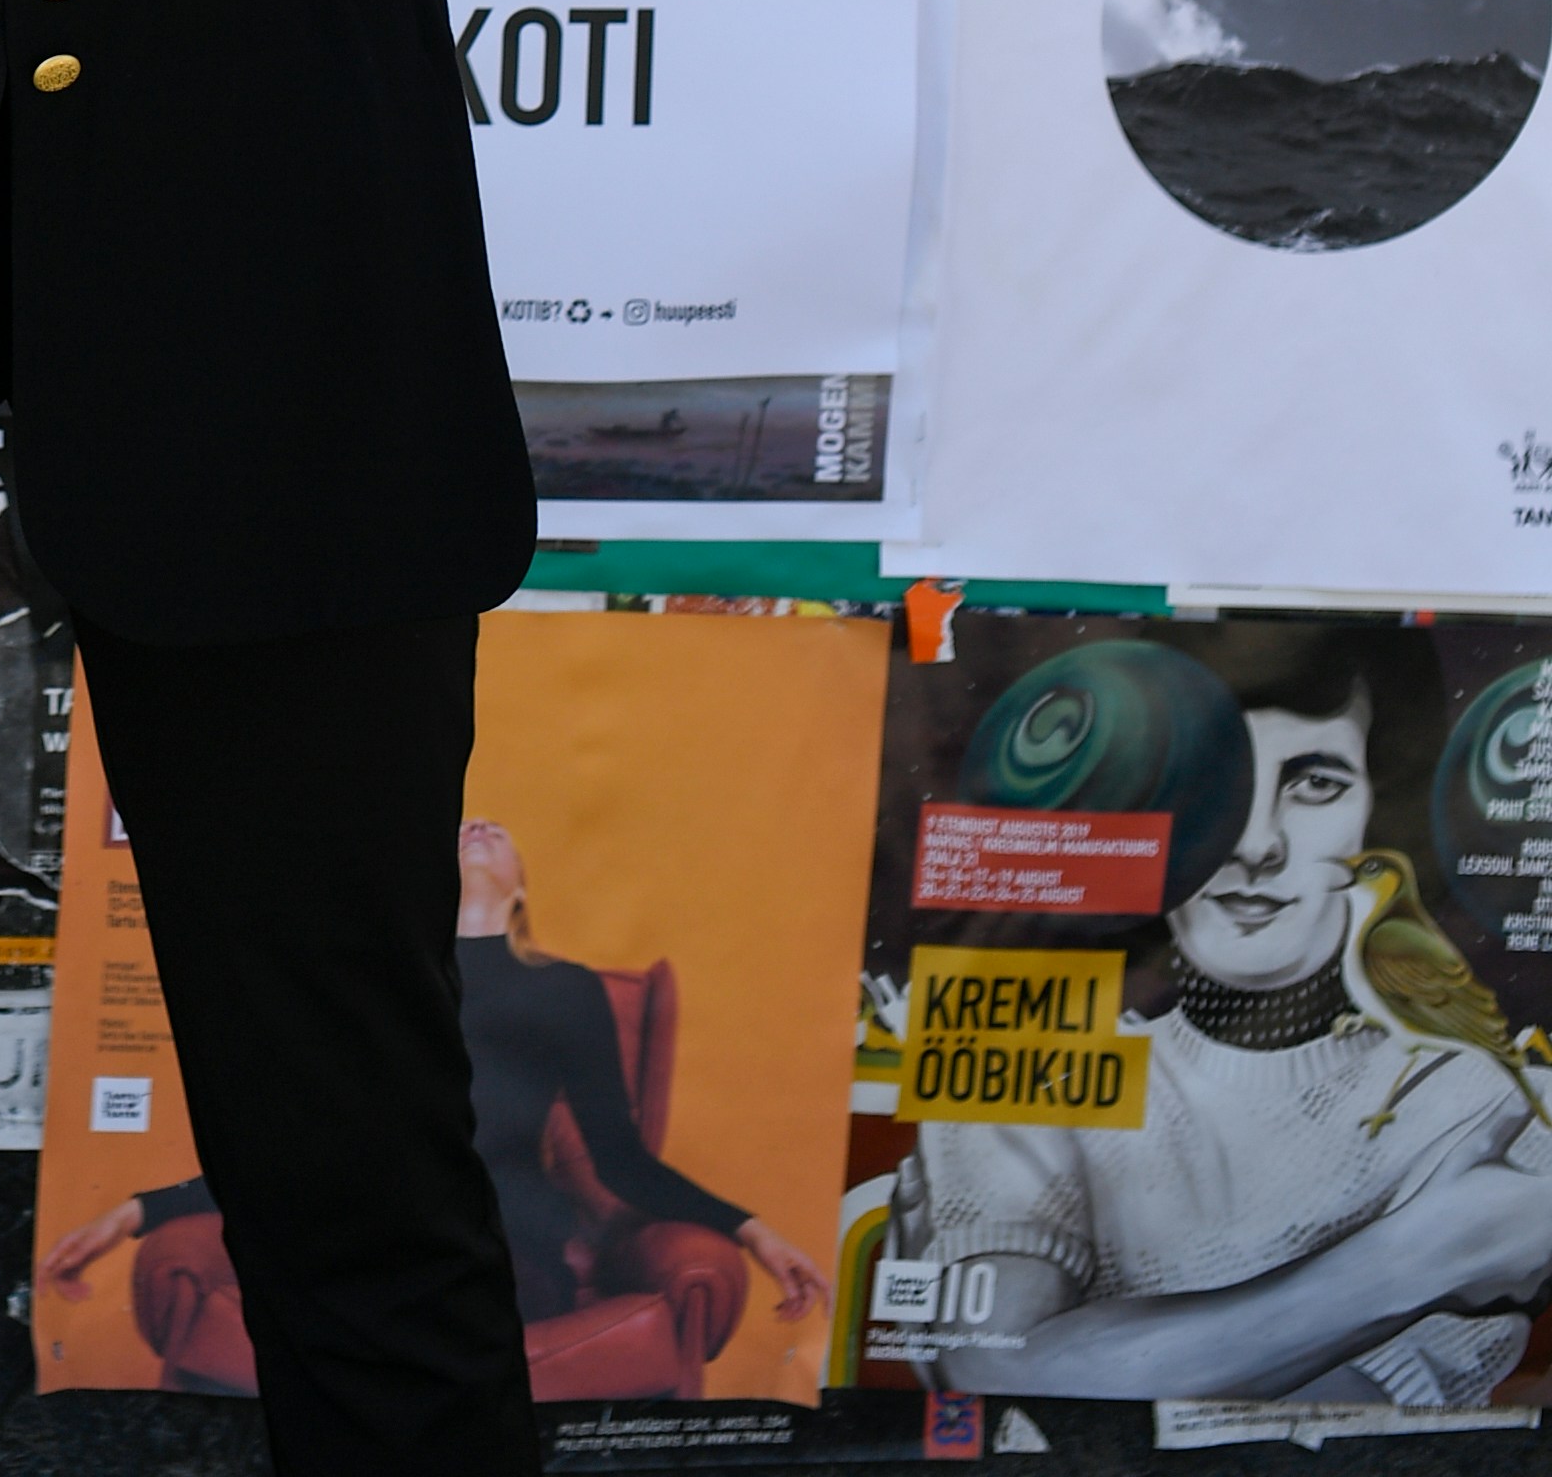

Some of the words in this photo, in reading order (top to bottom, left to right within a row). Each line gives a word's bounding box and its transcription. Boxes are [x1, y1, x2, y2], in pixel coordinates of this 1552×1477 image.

[653, 298, 738, 326] huupeesti
[922, 974, 1098, 1034] KREMLI
[914, 1035, 1125, 1109] ÖÖBIKUD
[941, 1262, 997, 1325] 10
